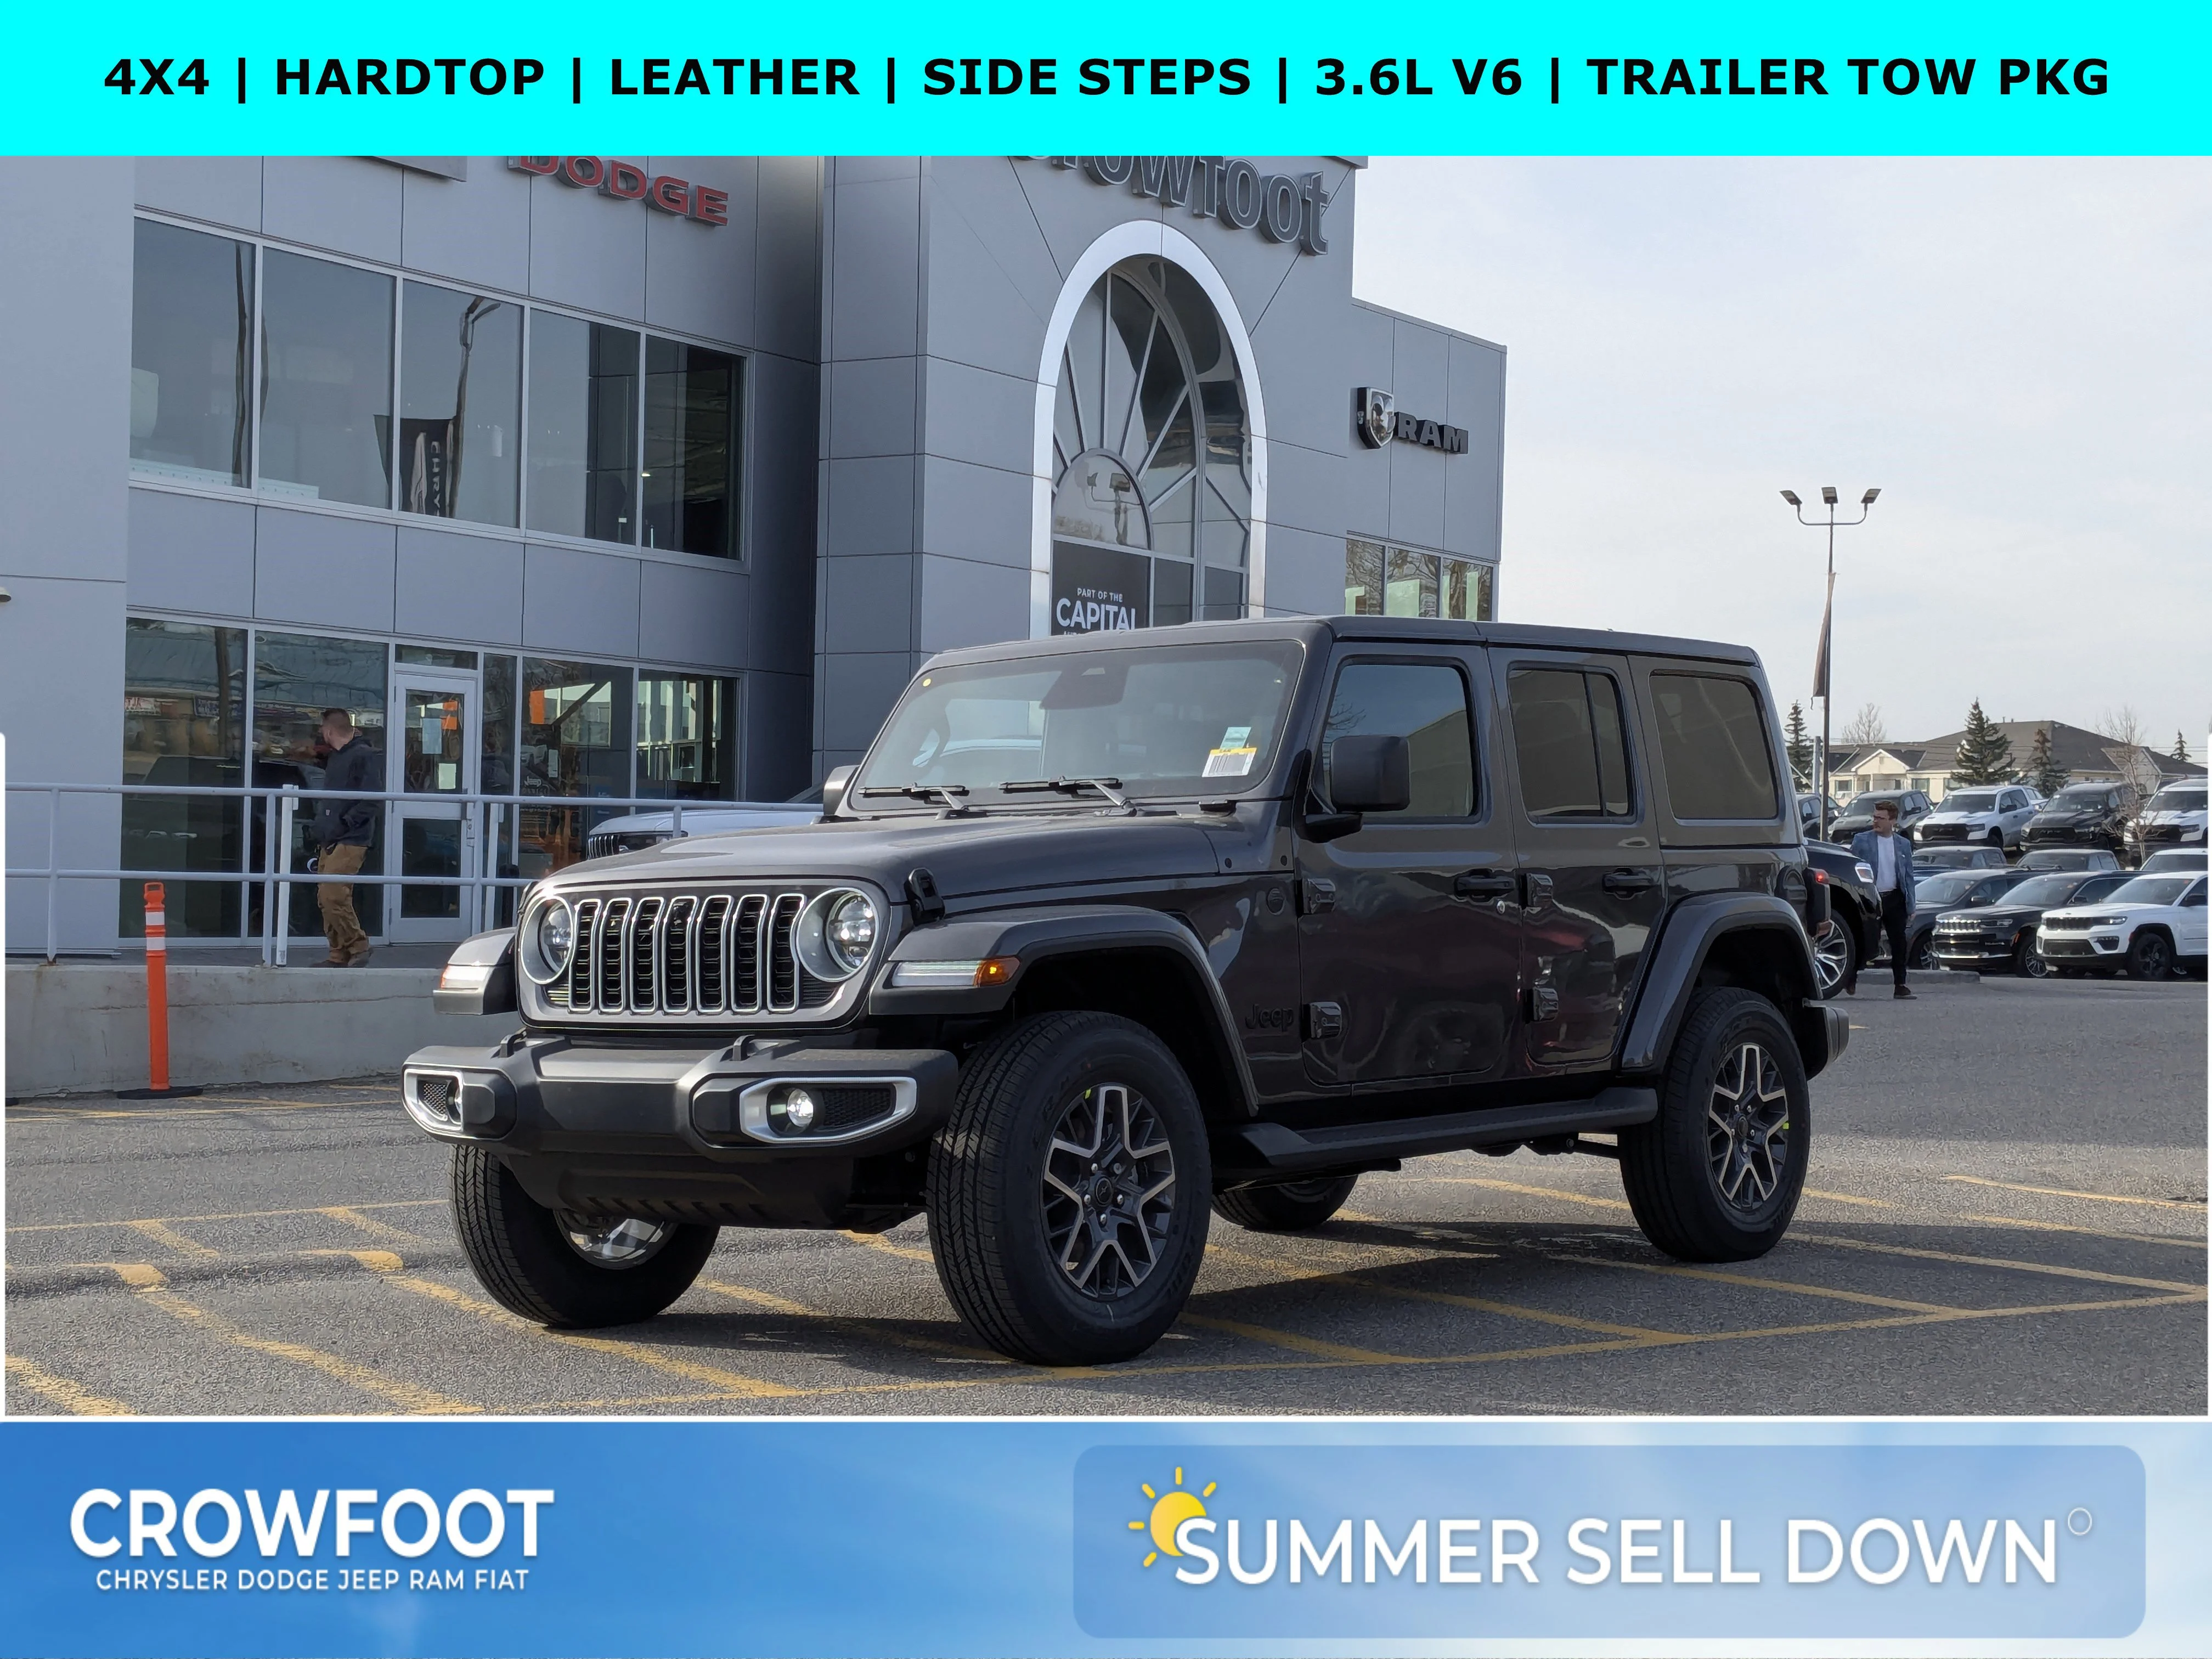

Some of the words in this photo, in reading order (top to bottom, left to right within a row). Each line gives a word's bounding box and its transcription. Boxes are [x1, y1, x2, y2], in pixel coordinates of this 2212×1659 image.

[1015, 156, 1329, 255] wfoot
[1395, 411, 1469, 454] RAM
[1077, 587, 1096, 599] PART
[1098, 590, 1108, 600] OF
[1110, 592, 1123, 602] THE
[1244, 1004, 1294, 1032] Jeep
